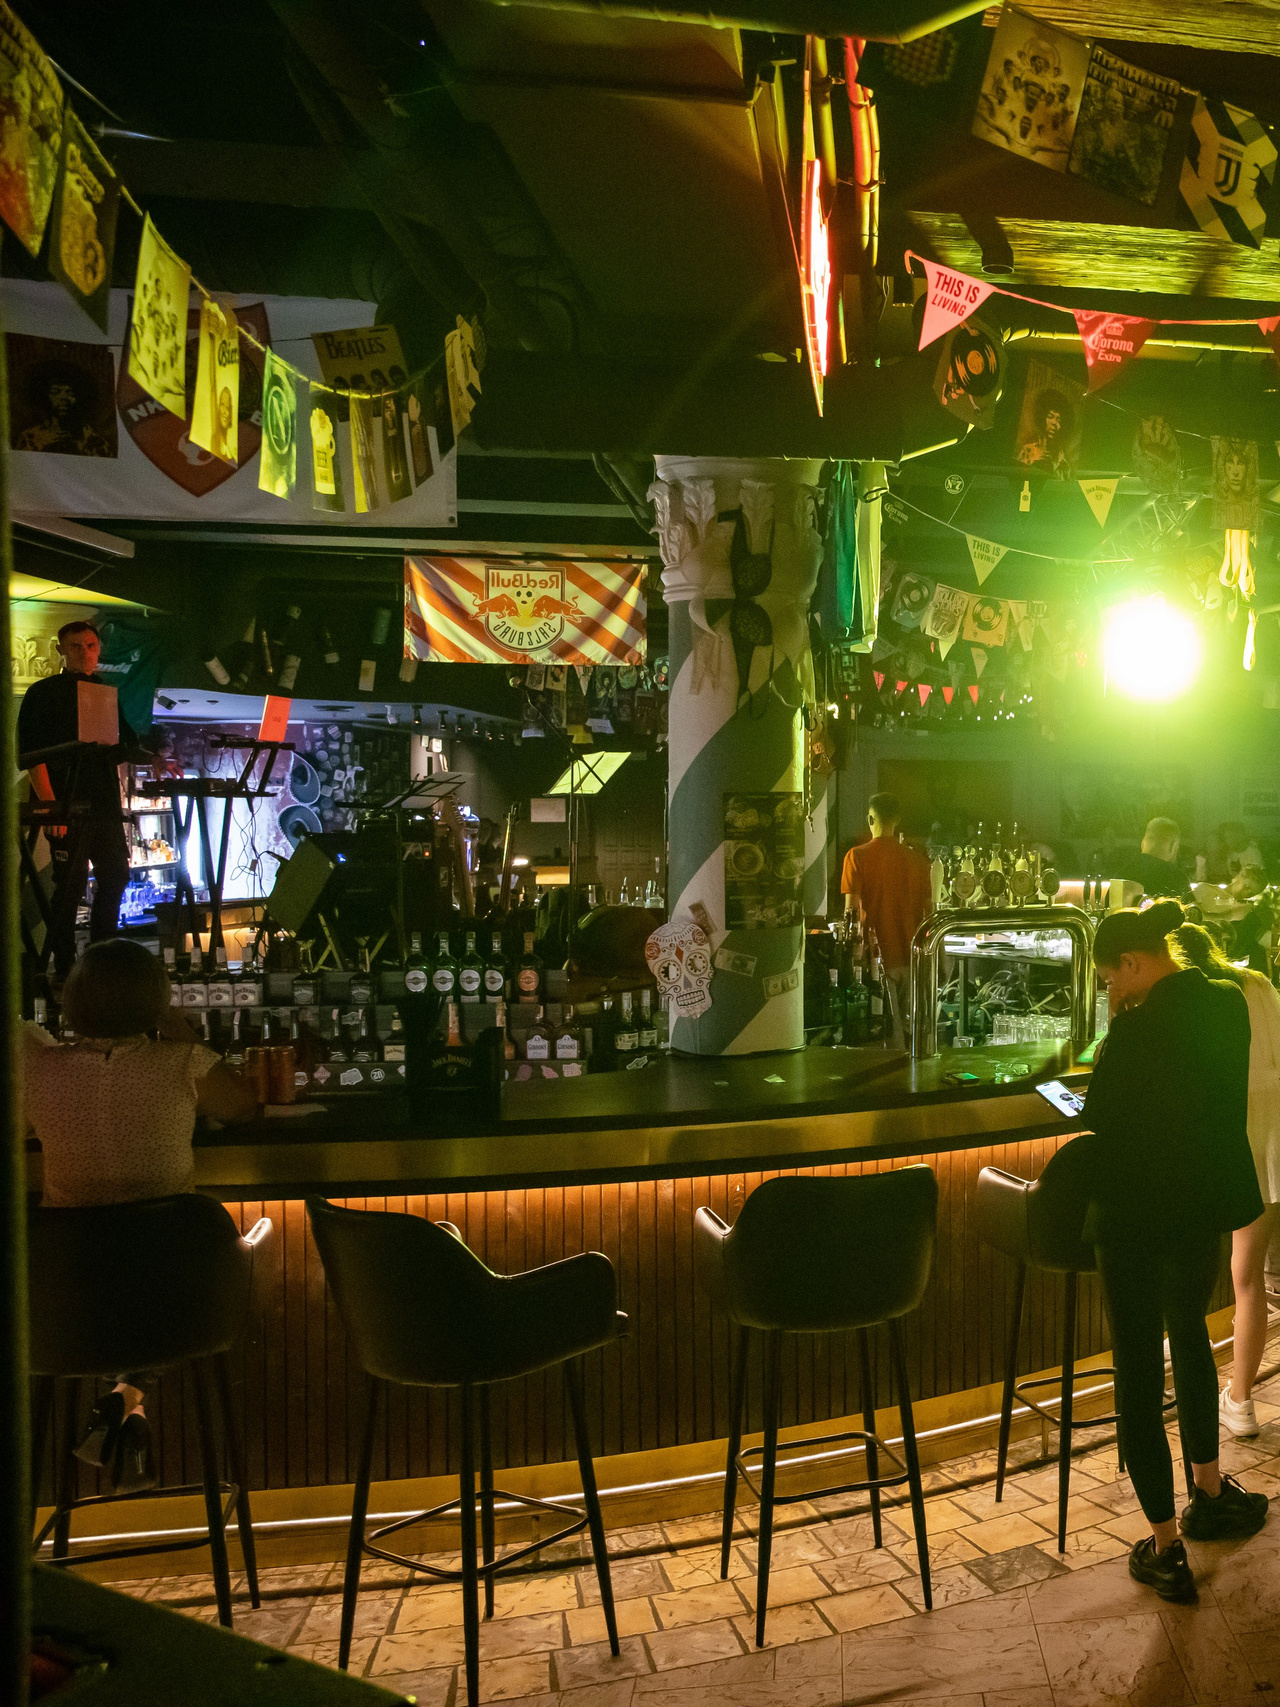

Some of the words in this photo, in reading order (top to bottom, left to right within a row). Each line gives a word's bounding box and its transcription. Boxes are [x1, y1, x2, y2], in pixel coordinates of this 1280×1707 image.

[935, 271, 964, 297] THIS
[965, 284, 980, 304] IS
[931, 295, 967, 317] LIVING
[323, 333, 387, 360] BEATLES
[1088, 335, 1134, 353] Corona
[1098, 352, 1122, 363] Extra
[972, 539, 990, 553] THIS
[991, 545, 1001, 557] IS
[973, 552, 996, 564] LIVING
